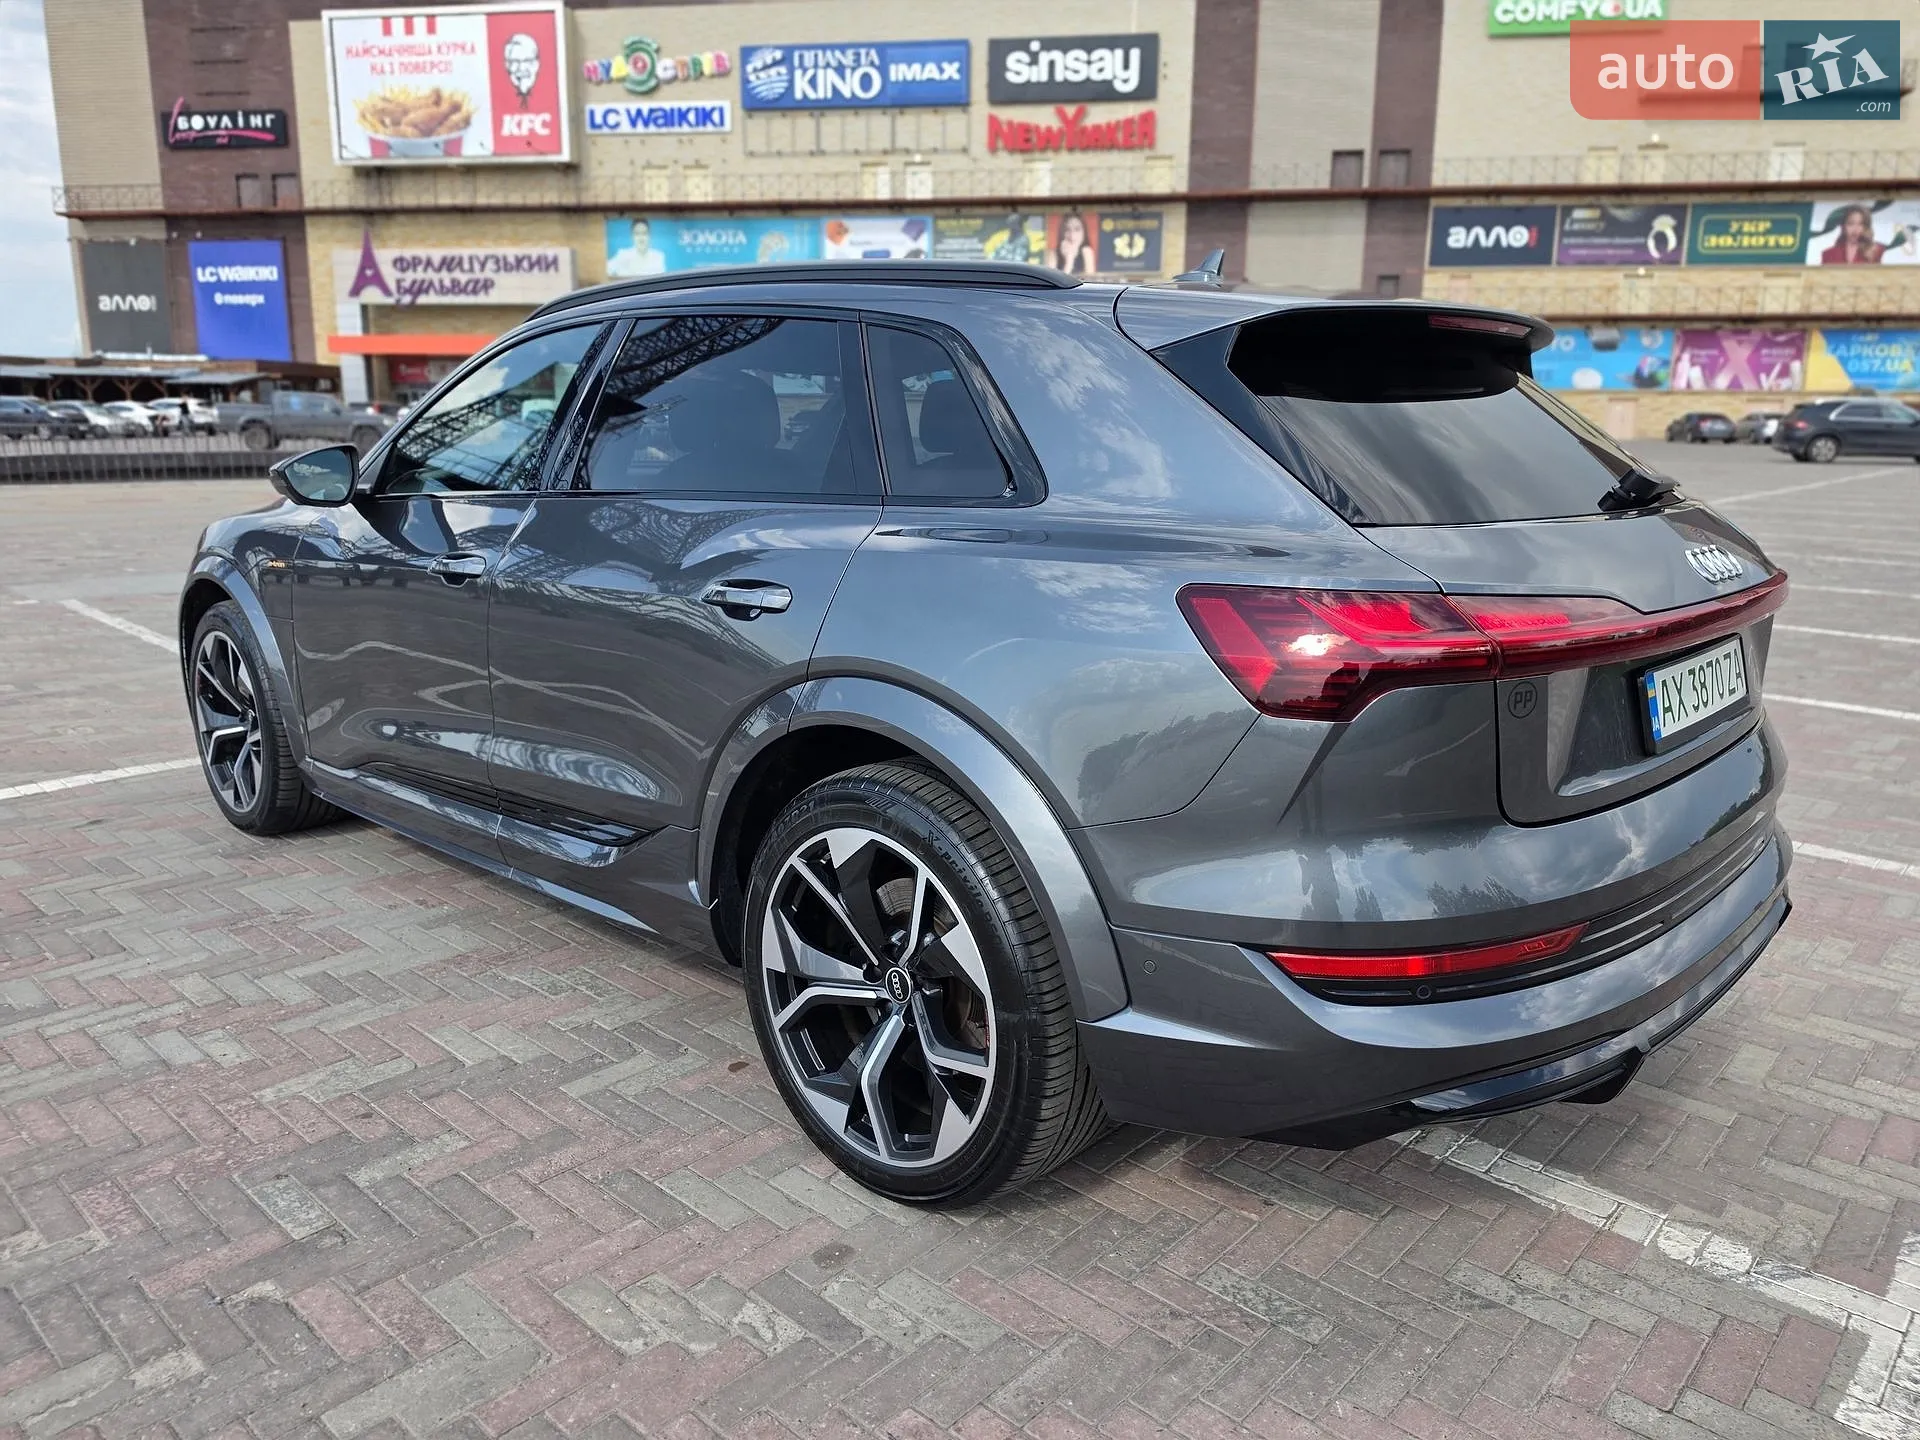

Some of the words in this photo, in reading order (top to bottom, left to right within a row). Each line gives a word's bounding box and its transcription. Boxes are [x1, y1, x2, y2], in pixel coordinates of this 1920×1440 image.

[889, 61, 961, 82] IMAX
[1005, 39, 1141, 93] sinsay
[793, 66, 882, 100] KINO
[501, 112, 552, 136] KFC
[589, 108, 621, 130] LC
[196, 266, 218, 283] LC
[1661, 672, 1688, 727] AX
[1687, 657, 1725, 713] 3870
[1723, 648, 1744, 697] ZA
[1513, 689, 1535, 710] PP
